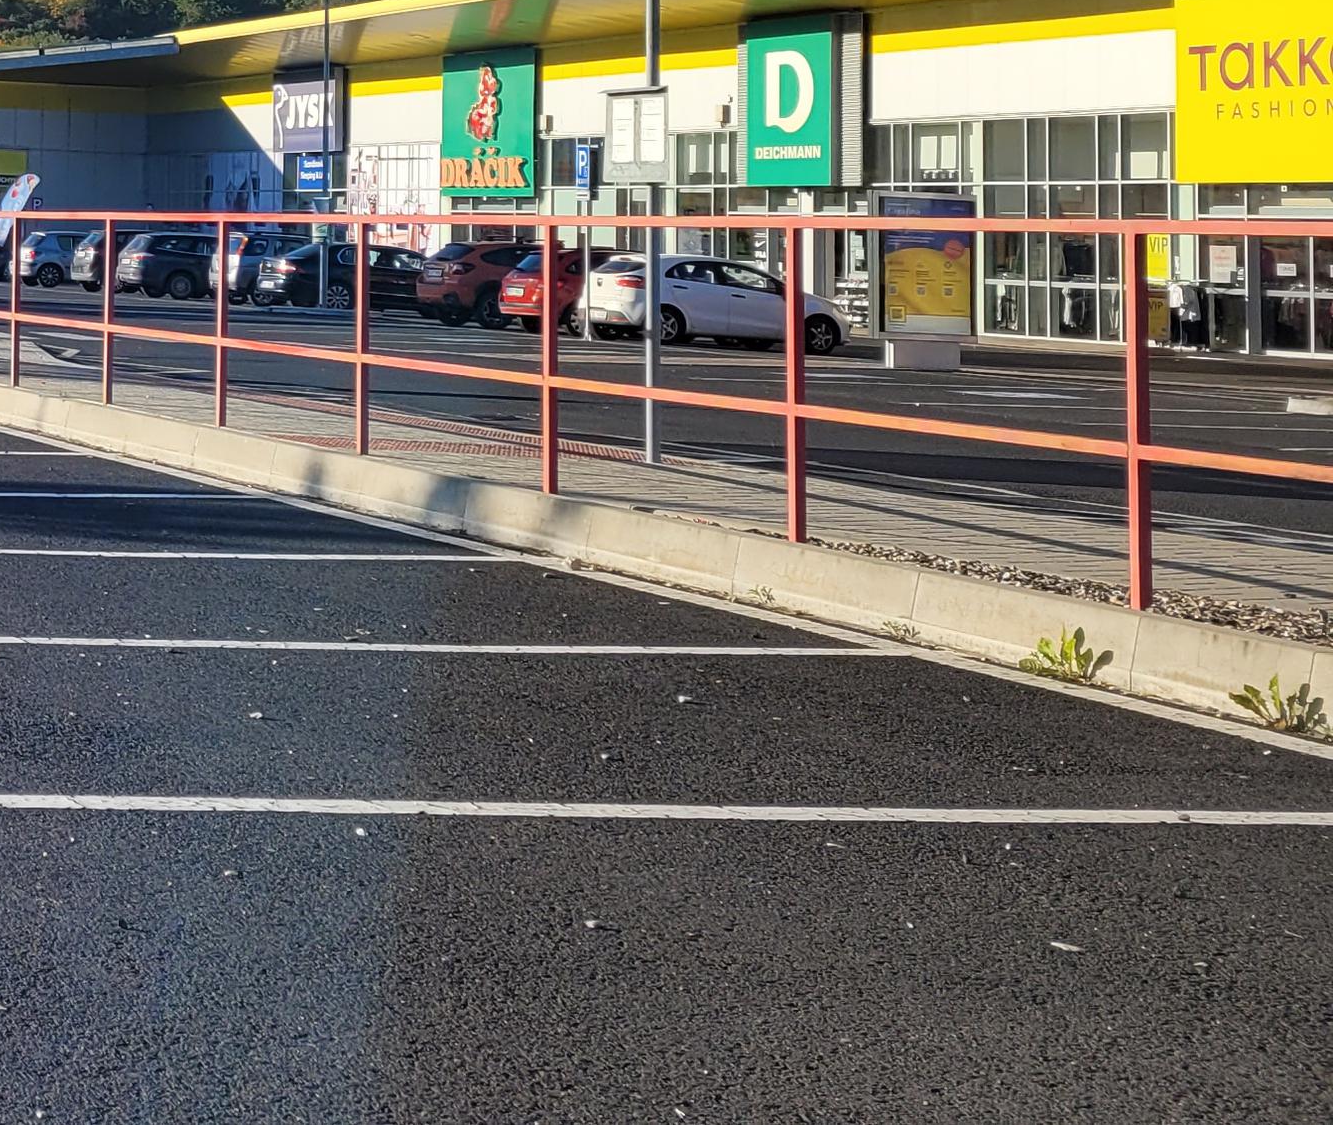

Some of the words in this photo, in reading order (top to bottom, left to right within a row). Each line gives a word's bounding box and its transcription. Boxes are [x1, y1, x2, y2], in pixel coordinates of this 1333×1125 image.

[1188, 37, 1333, 91] TaKK
[765, 50, 814, 133] D
[286, 92, 334, 129] JYSK
[579, 150, 587, 177] P
[755, 145, 821, 160] DEICHMANN
[1149, 236, 1168, 253] VIP
